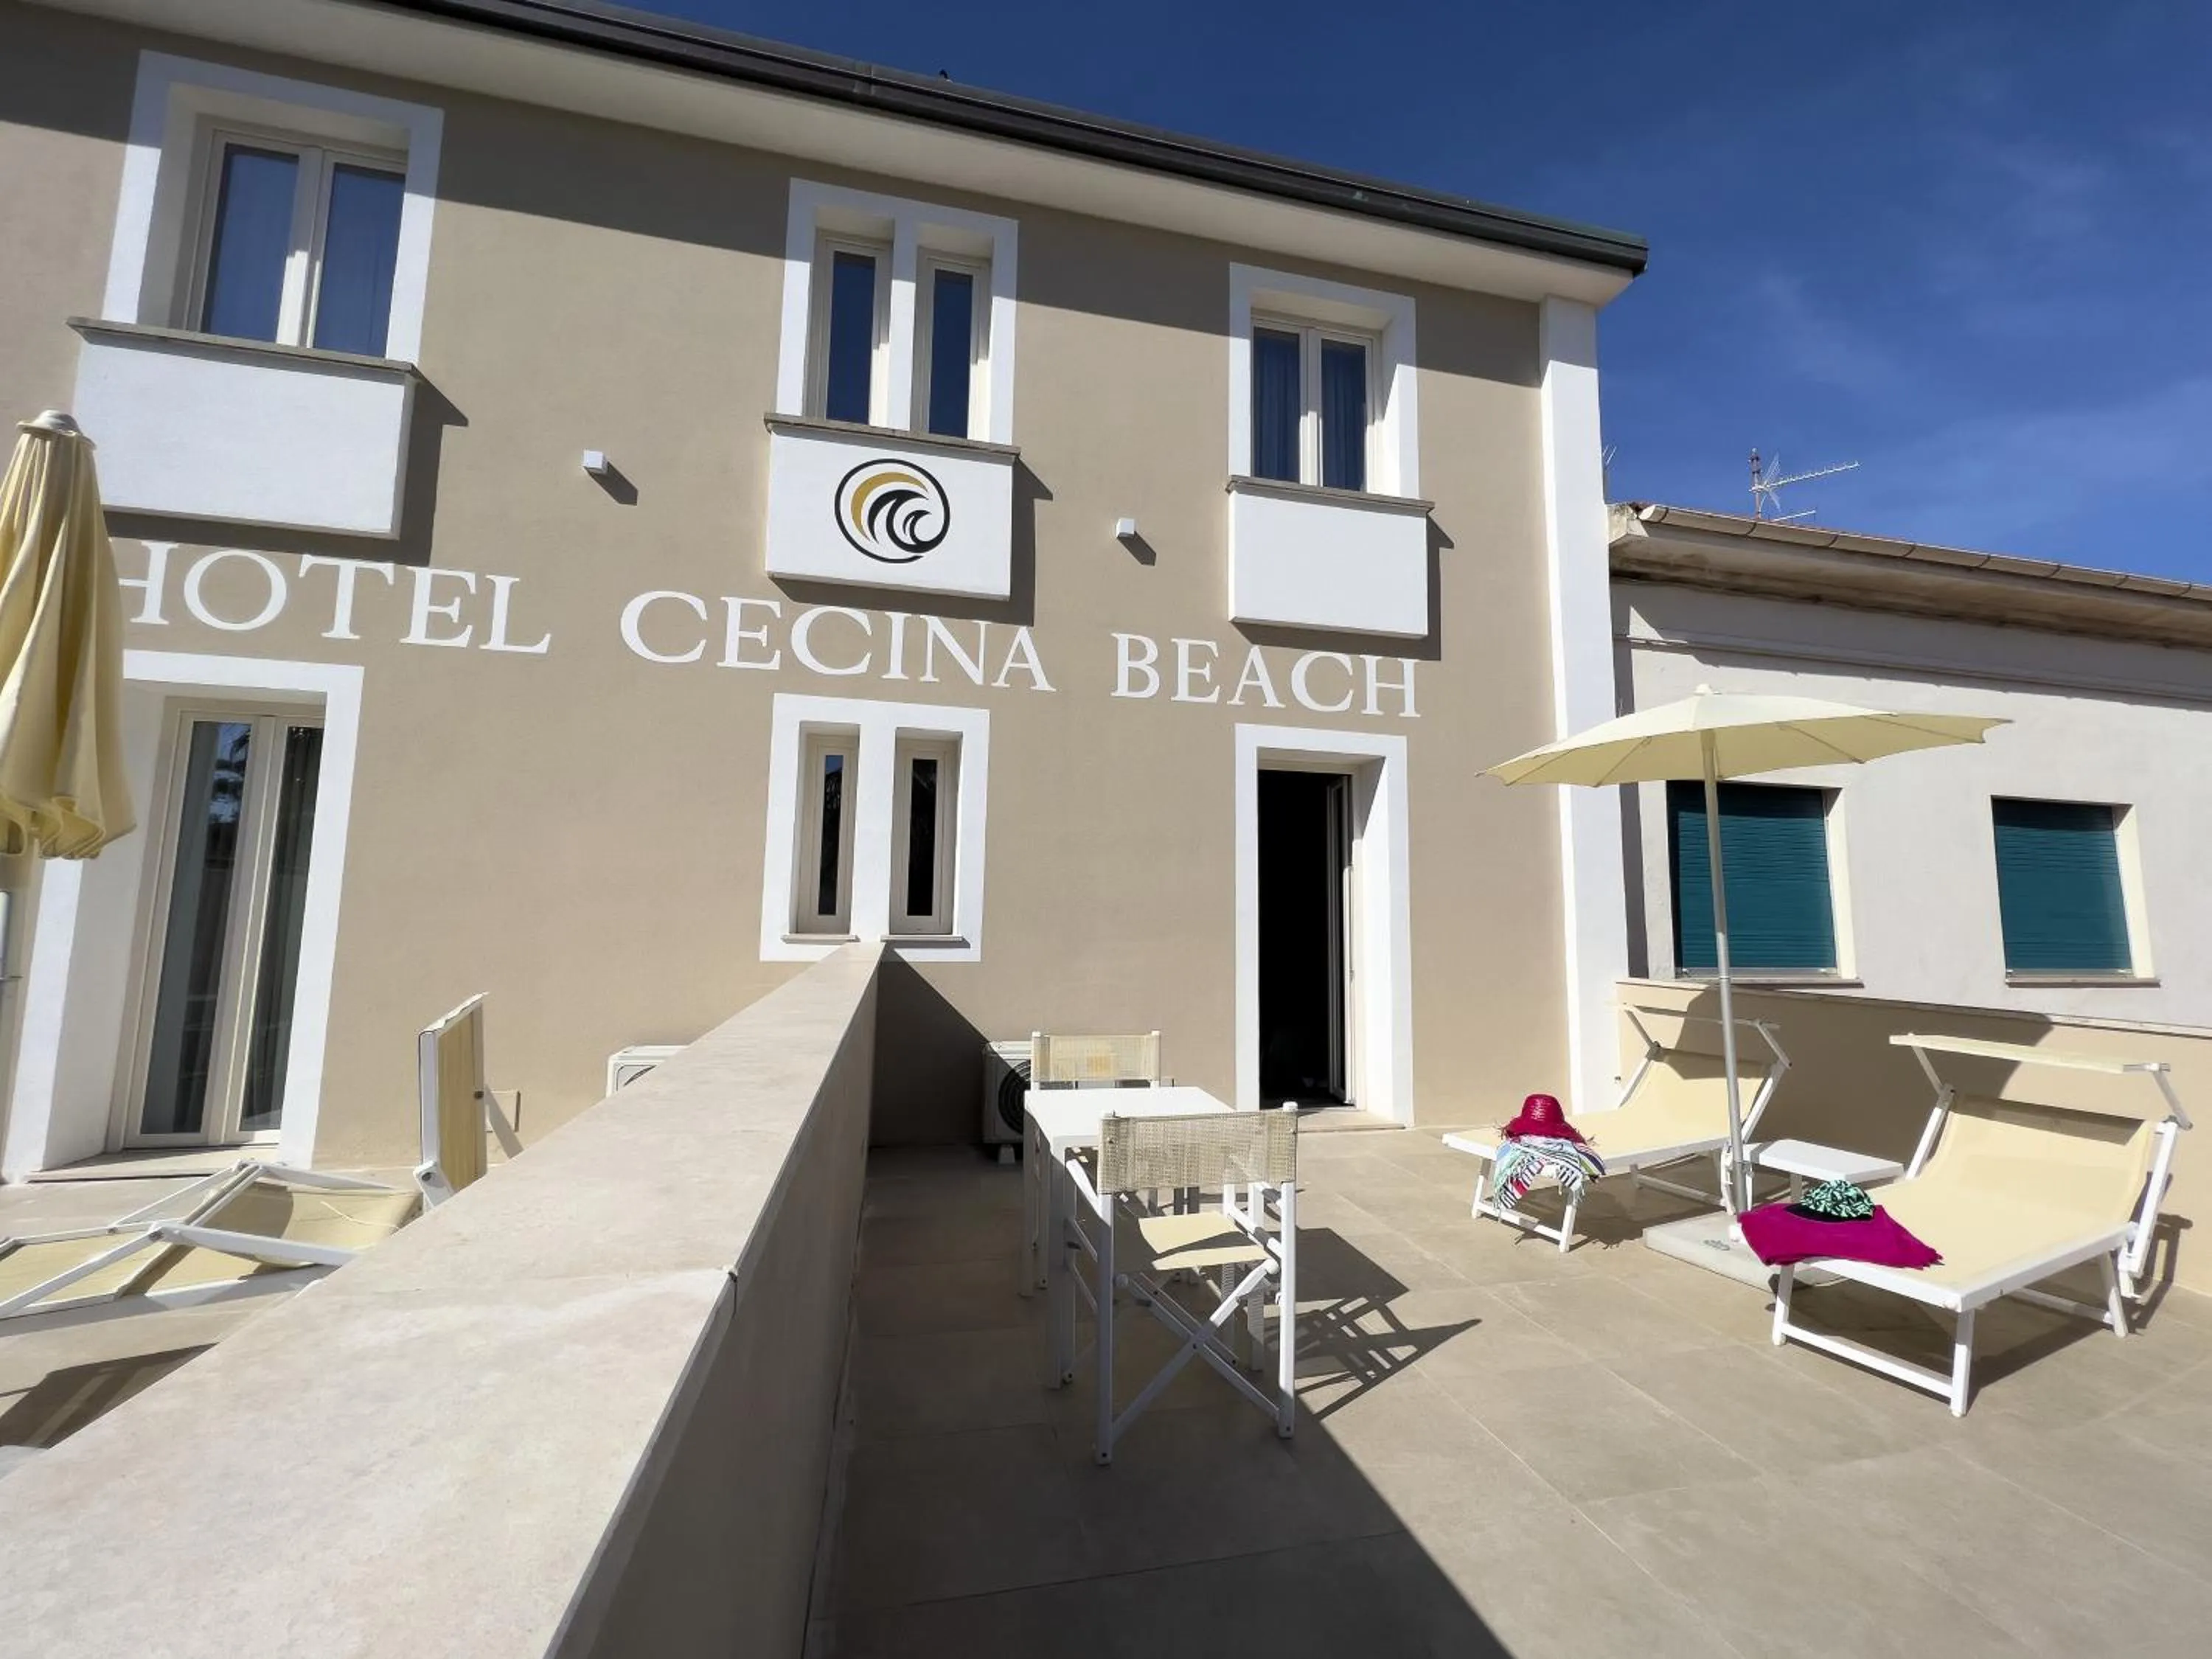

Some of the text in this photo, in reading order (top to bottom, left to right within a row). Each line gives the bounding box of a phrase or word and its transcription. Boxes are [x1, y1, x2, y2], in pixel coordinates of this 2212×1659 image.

[116, 540, 1422, 717] HOTEL CECINA BEACH
